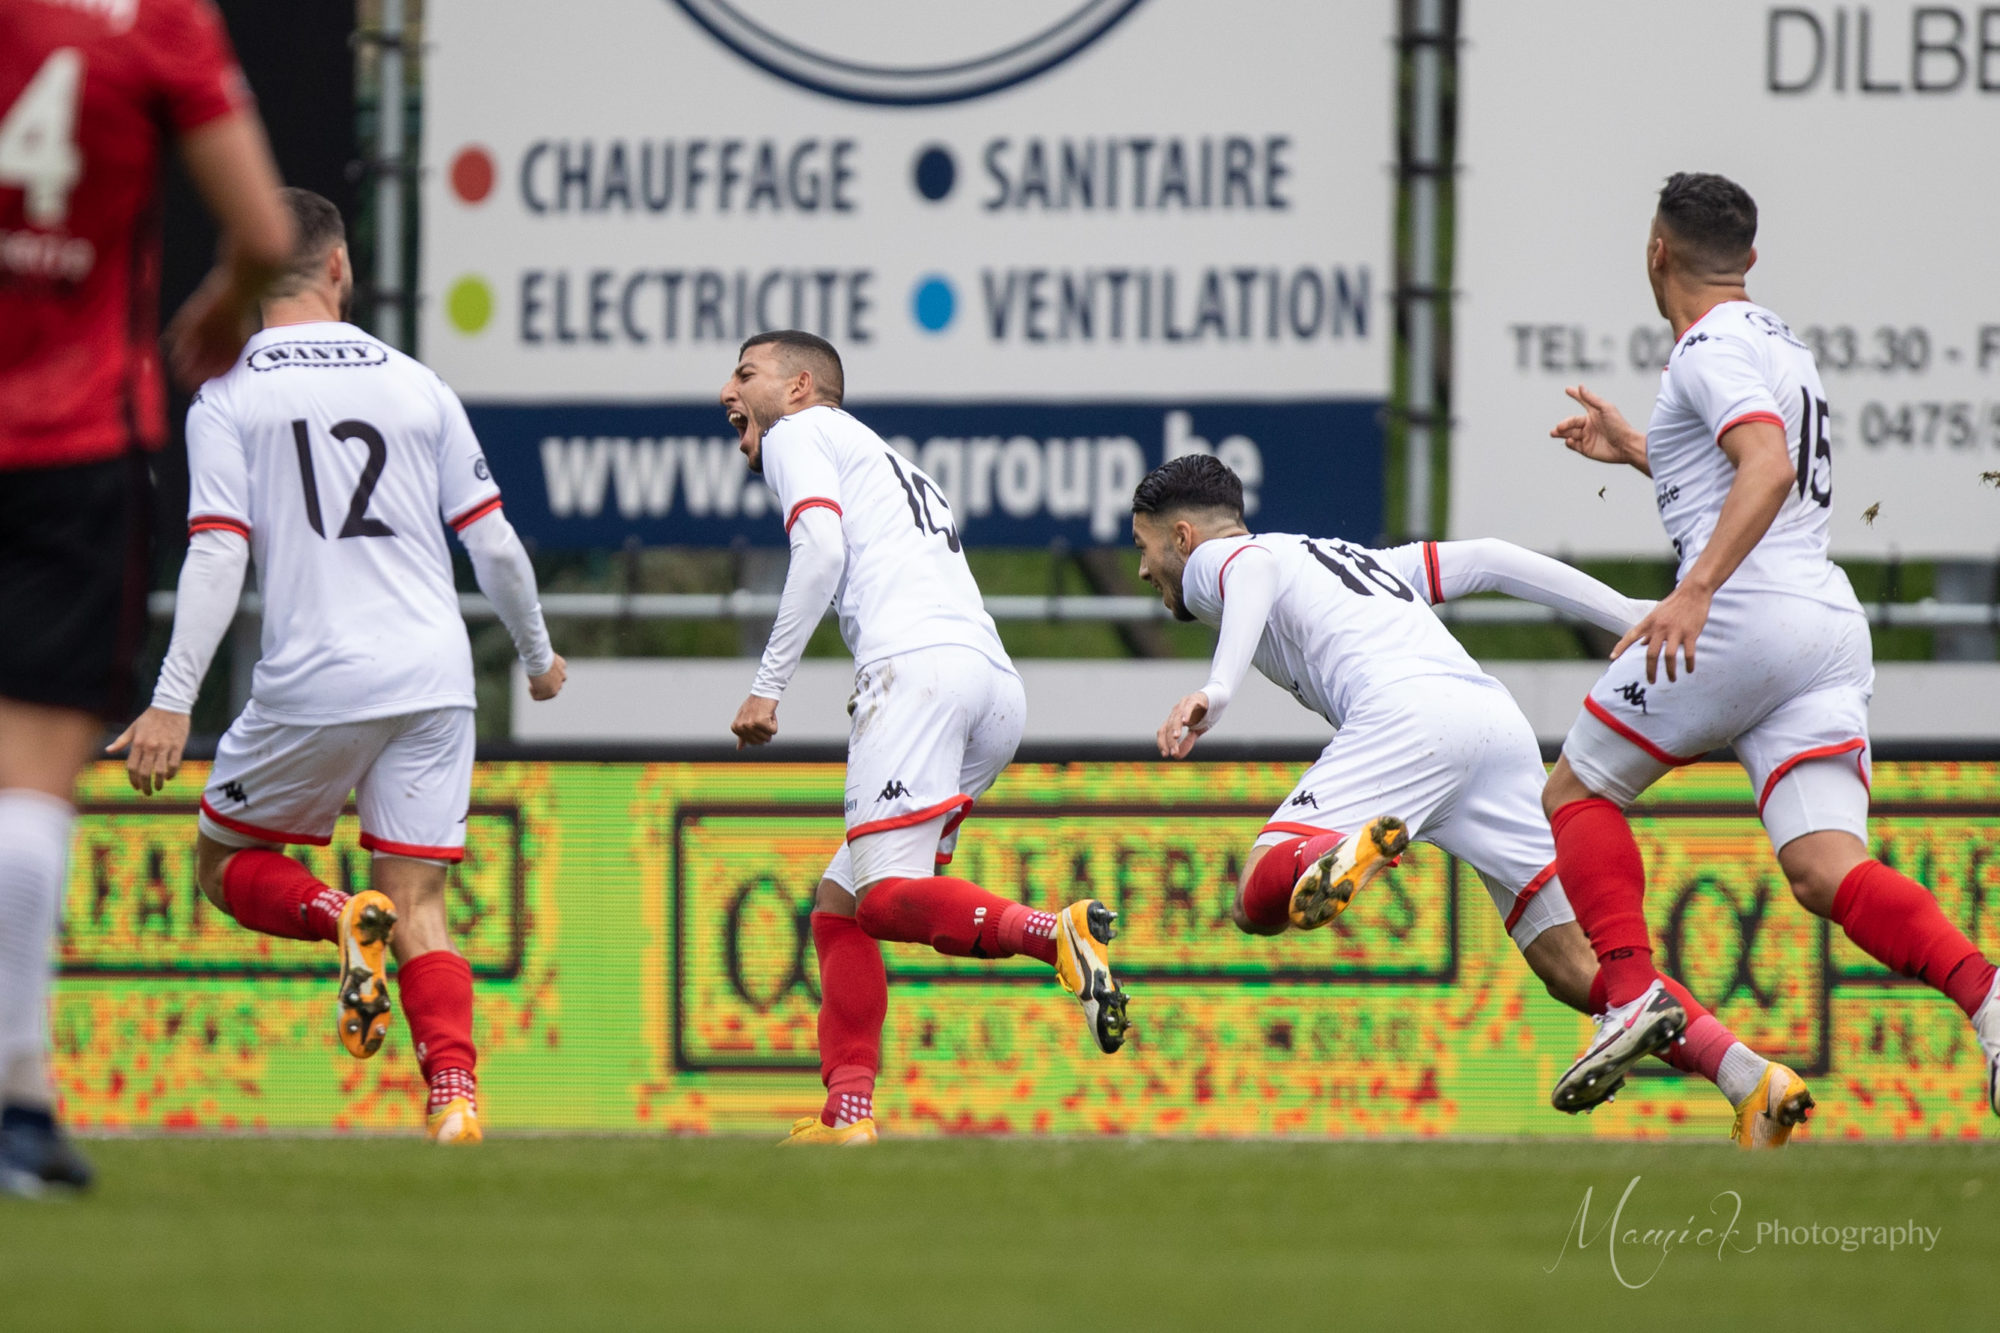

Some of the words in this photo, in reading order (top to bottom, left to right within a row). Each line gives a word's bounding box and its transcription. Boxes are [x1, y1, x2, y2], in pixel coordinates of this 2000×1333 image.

[520, 137, 858, 214] CHAUFFAGE
[982, 134, 1292, 212] SANITAIRE
[520, 268, 876, 344] ELECTRICITE
[980, 265, 1371, 342] VENTILATION
[263, 344, 372, 364] WANTY
[292, 418, 398, 540] 12
[1797, 385, 1832, 507] 15
